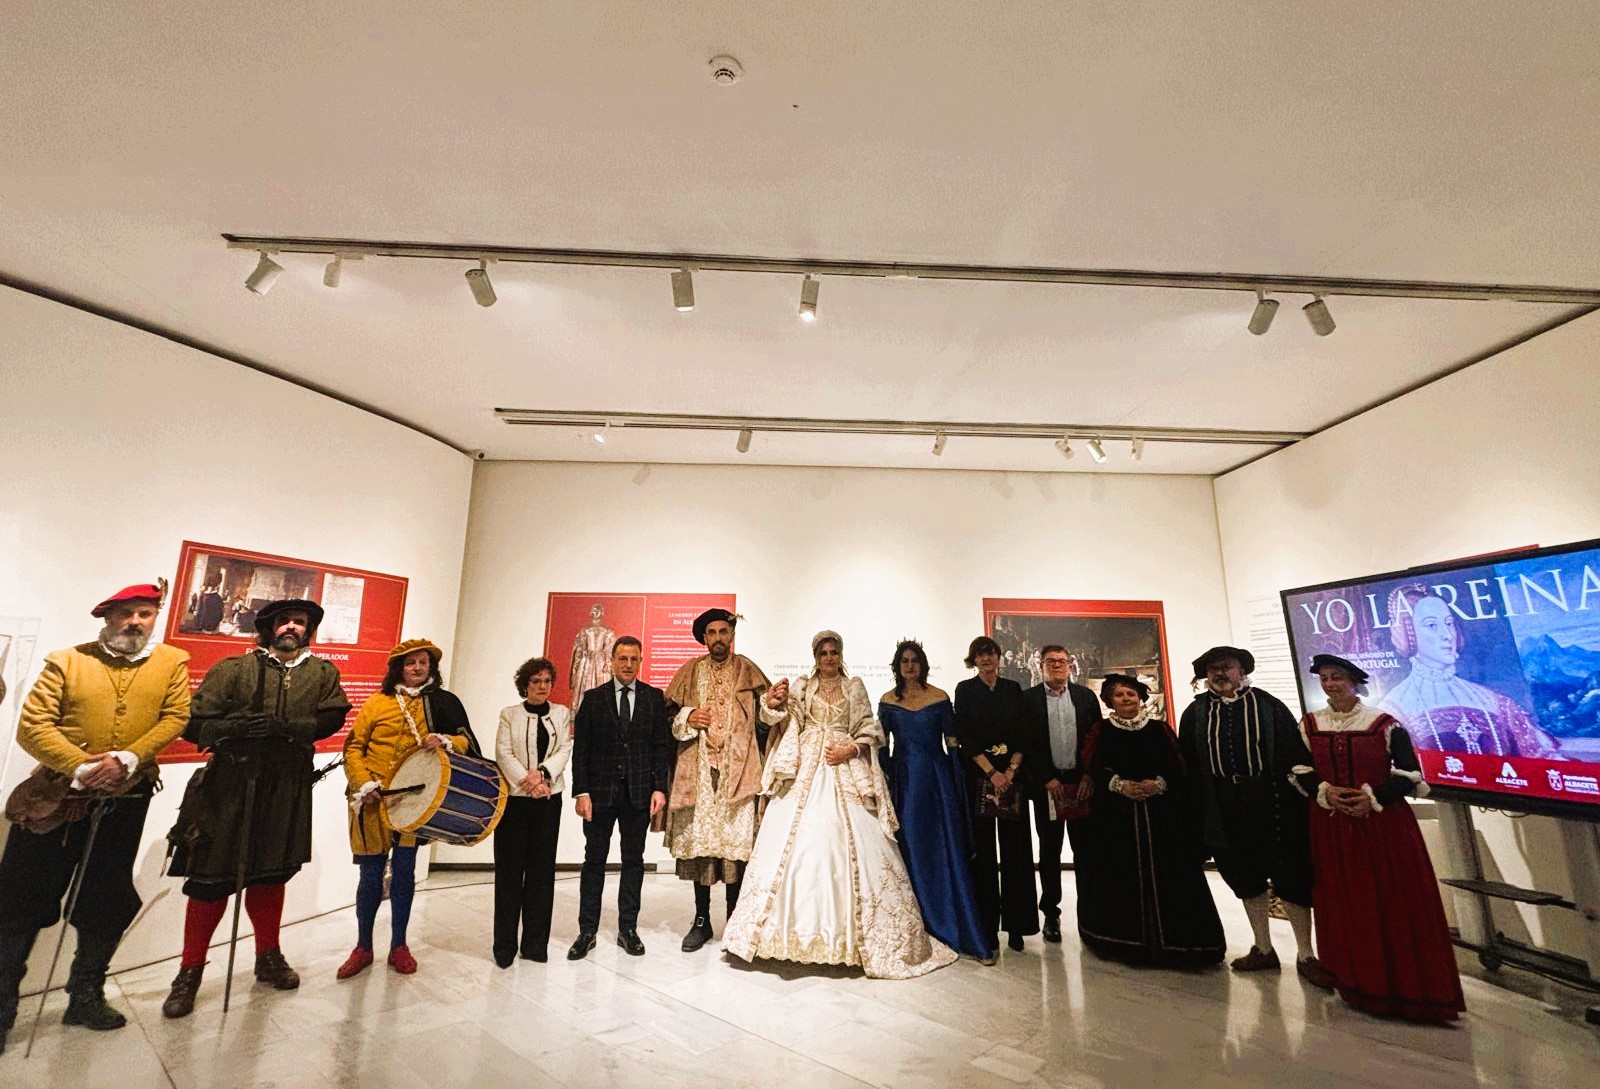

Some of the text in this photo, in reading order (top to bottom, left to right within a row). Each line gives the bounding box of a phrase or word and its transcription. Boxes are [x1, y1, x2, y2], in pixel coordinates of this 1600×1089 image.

[1301, 564, 1600, 635] YO LA REINA
[313, 653, 349, 661] MPERADOR
[1495, 777, 1528, 787] ALBACETE
